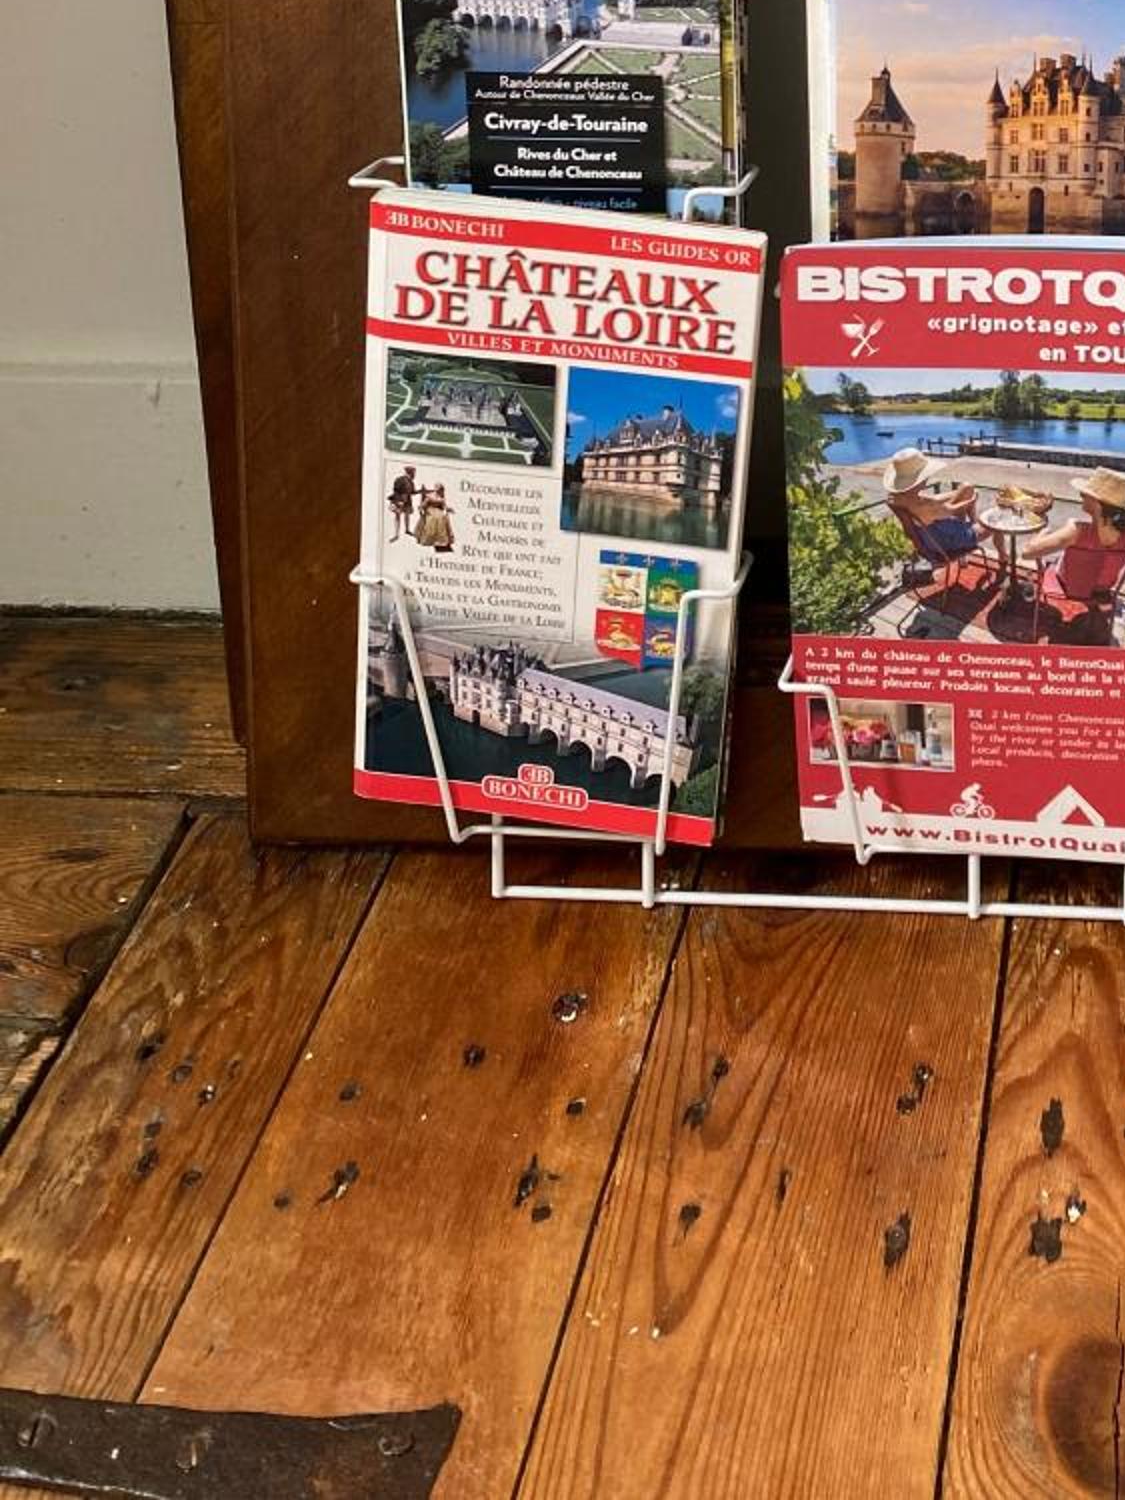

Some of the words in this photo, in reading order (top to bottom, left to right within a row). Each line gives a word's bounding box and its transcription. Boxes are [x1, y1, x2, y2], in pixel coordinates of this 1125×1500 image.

[500, 76, 571, 89] Randonnée
[575, 77, 629, 92] pédestre
[484, 112, 648, 135] Civray-de-Touraine
[518, 147, 551, 161] Rives
[553, 148, 568, 161] du
[571, 148, 602, 162] Cher
[604, 151, 617, 162] et
[494, 164, 546, 179] Château
[548, 166, 564, 179] de
[566, 166, 642, 181] Chenonceau
[412, 216, 504, 238] BONECHI
[611, 235, 642, 253] LES
[648, 241, 719, 262] GUIDES
[725, 251, 751, 266] OR
[416, 249, 720, 314] CHÂTEAUX
[393, 284, 469, 326] DE
[488, 295, 555, 334] LA
[573, 303, 736, 354] LOIRE
[928, 314, 1098, 335] «grignotage»
[447, 331, 513, 351] VILLES
[520, 337, 542, 356] ET
[550, 341, 679, 369] MONUMENTS
[1039, 347, 1067, 361] en
[836, 647, 855, 658] km
[861, 649, 877, 659] du
[937, 652, 952, 663] de
[1047, 670, 1076, 682] bord
[1081, 672, 1096, 683] de
[489, 780, 581, 806] BONECHI
